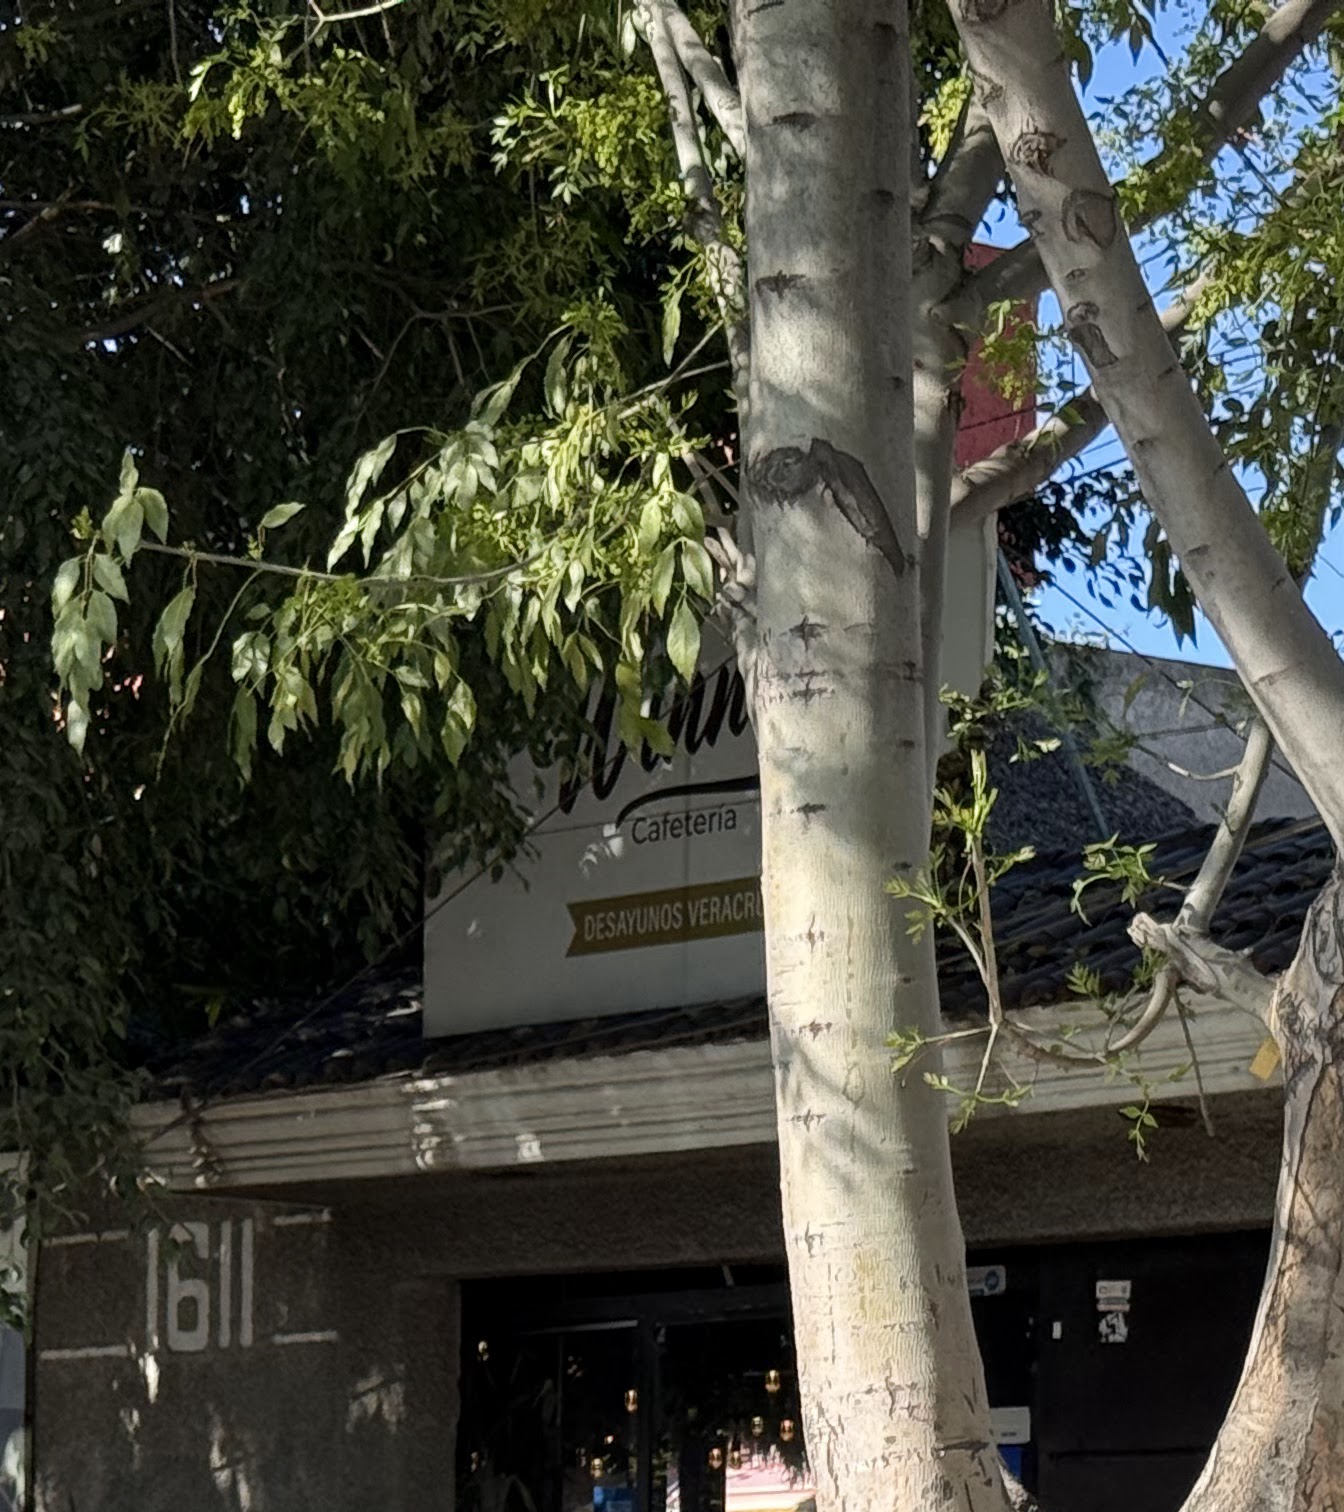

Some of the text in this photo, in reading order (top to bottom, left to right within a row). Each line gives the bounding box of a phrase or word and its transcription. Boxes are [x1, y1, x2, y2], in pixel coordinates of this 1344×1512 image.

[631, 803, 738, 845] Cafetería
[583, 904, 684, 942] DESAYUNOS
[146, 1218, 254, 1352] 1611
